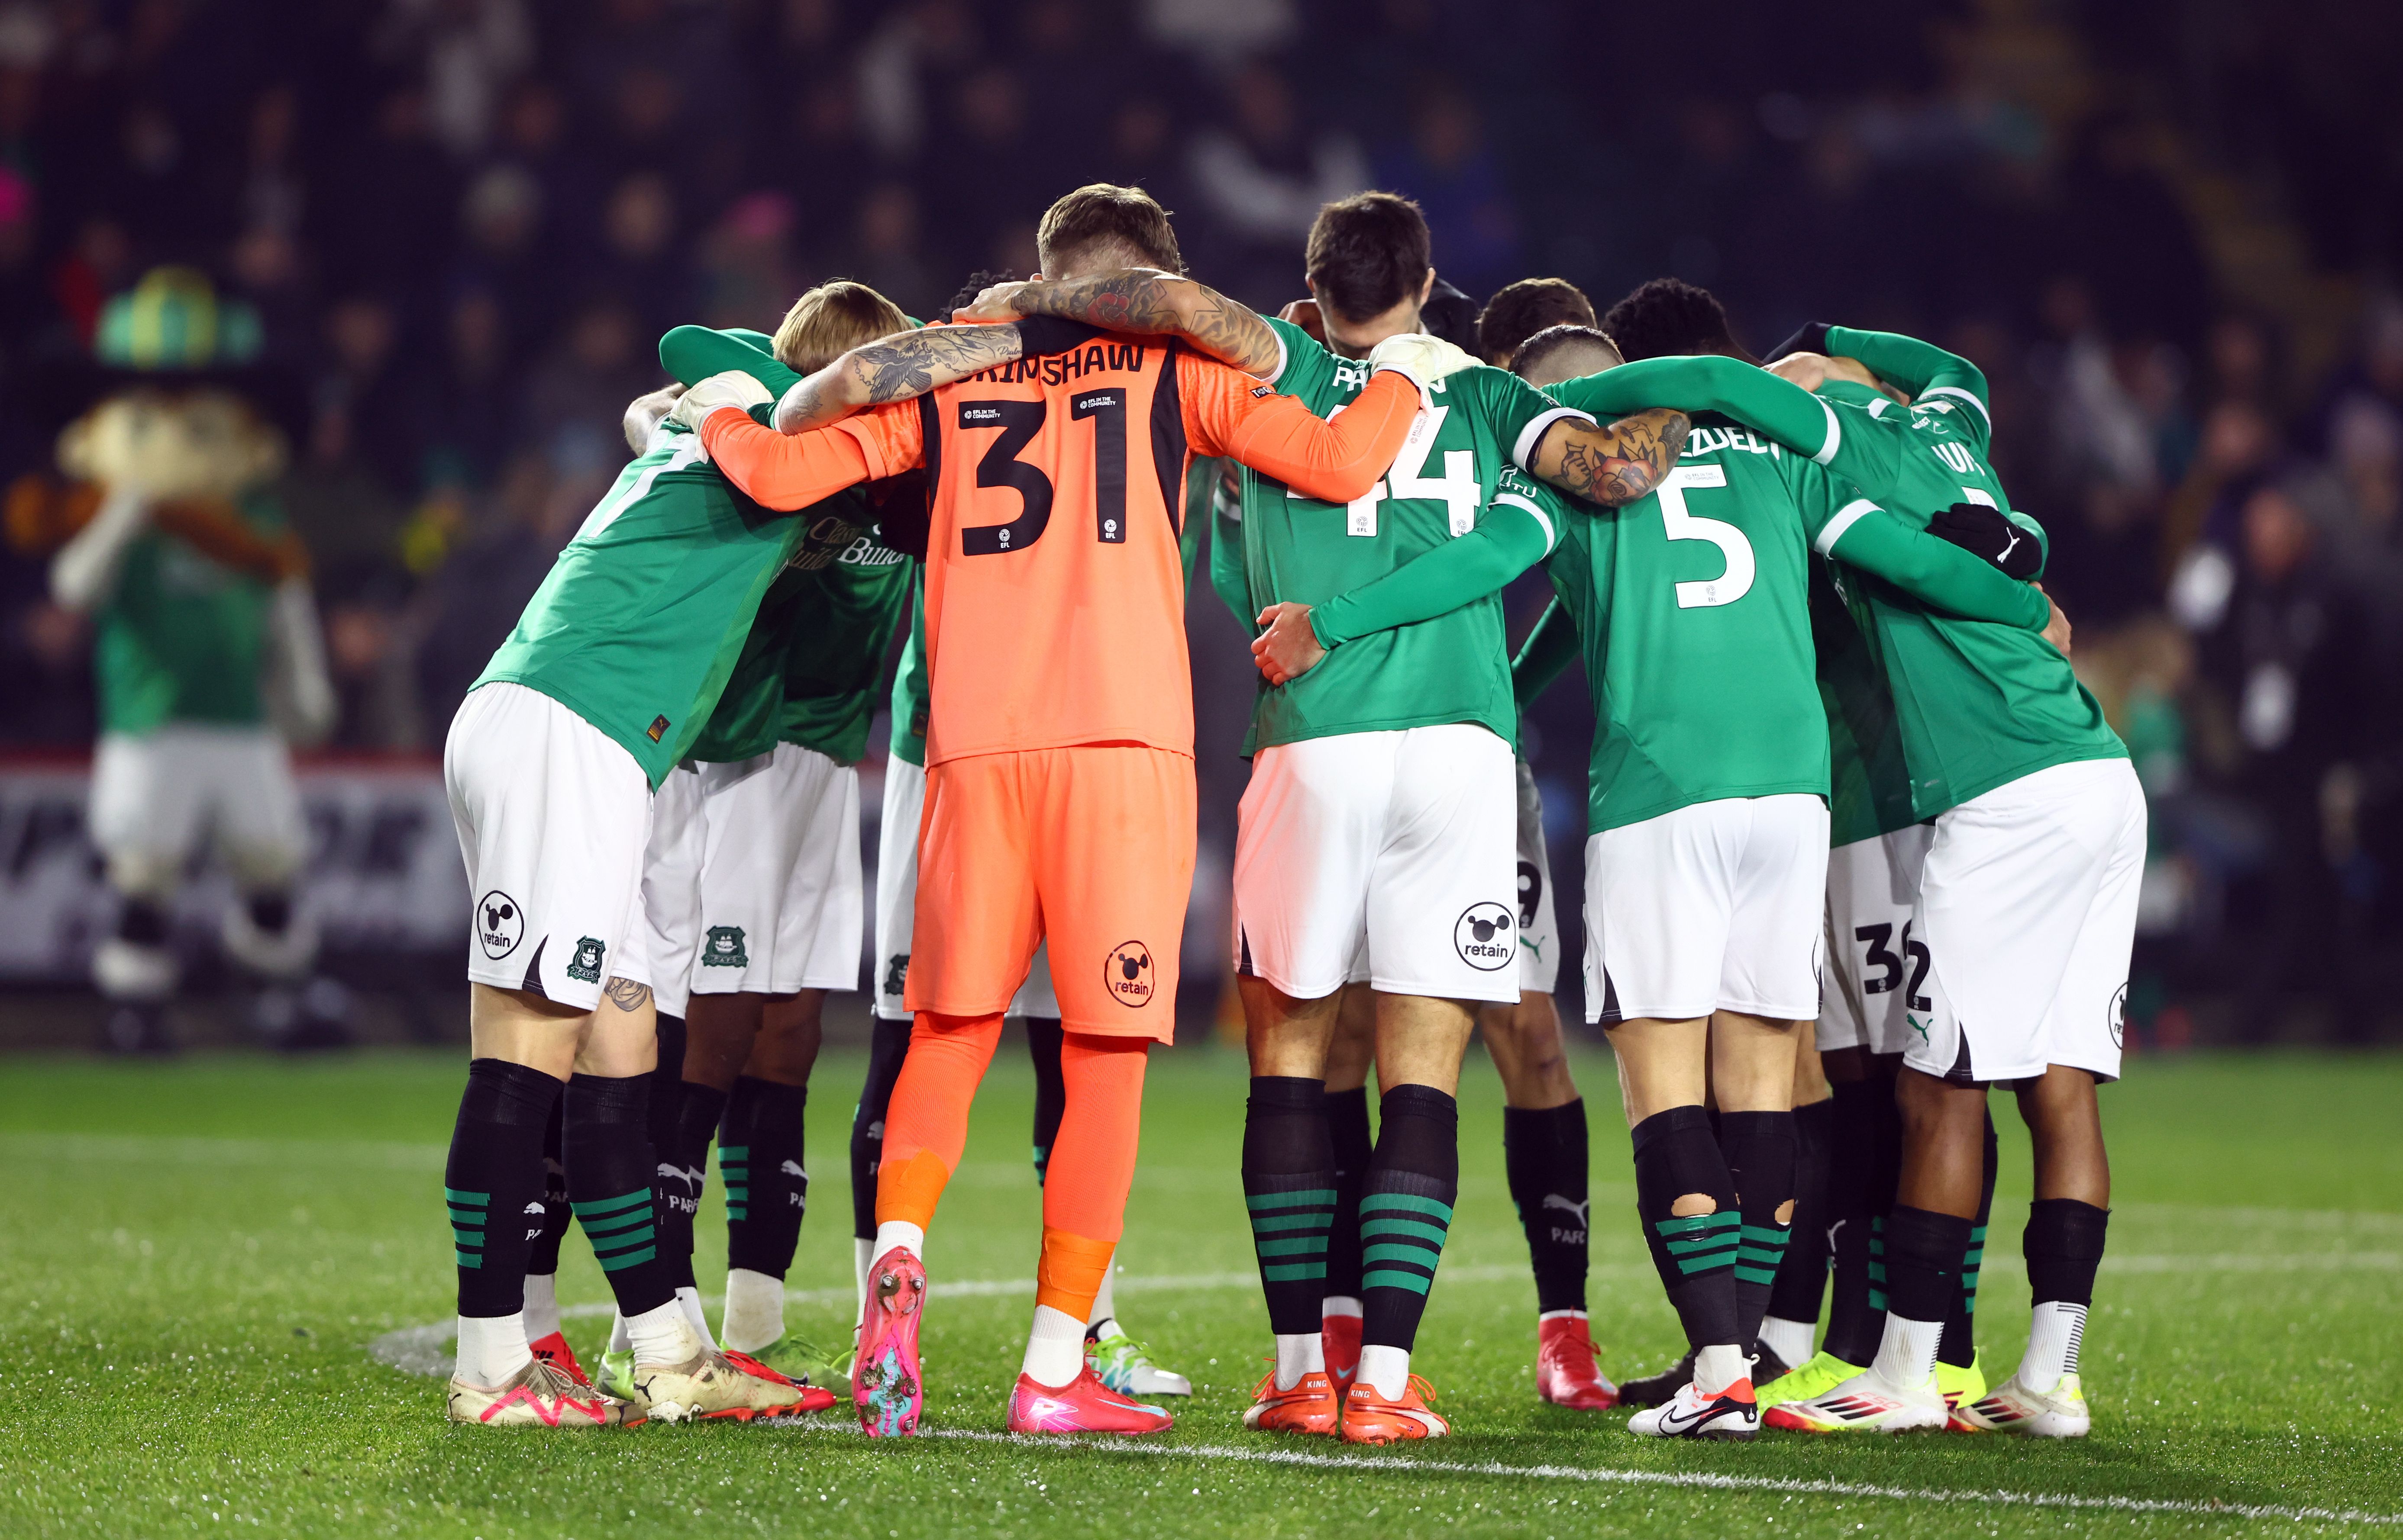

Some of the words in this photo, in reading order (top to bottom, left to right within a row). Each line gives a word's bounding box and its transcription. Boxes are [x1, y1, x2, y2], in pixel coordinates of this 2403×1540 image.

[958, 388, 1126, 556] 31
[1654, 463, 1757, 609] 5
[484, 933, 510, 948] retain
[1465, 943, 1508, 958] retain
[1115, 981, 1148, 996] retain
[1307, 1380, 1327, 1388] KING
[1350, 1389, 1371, 1398] KING
